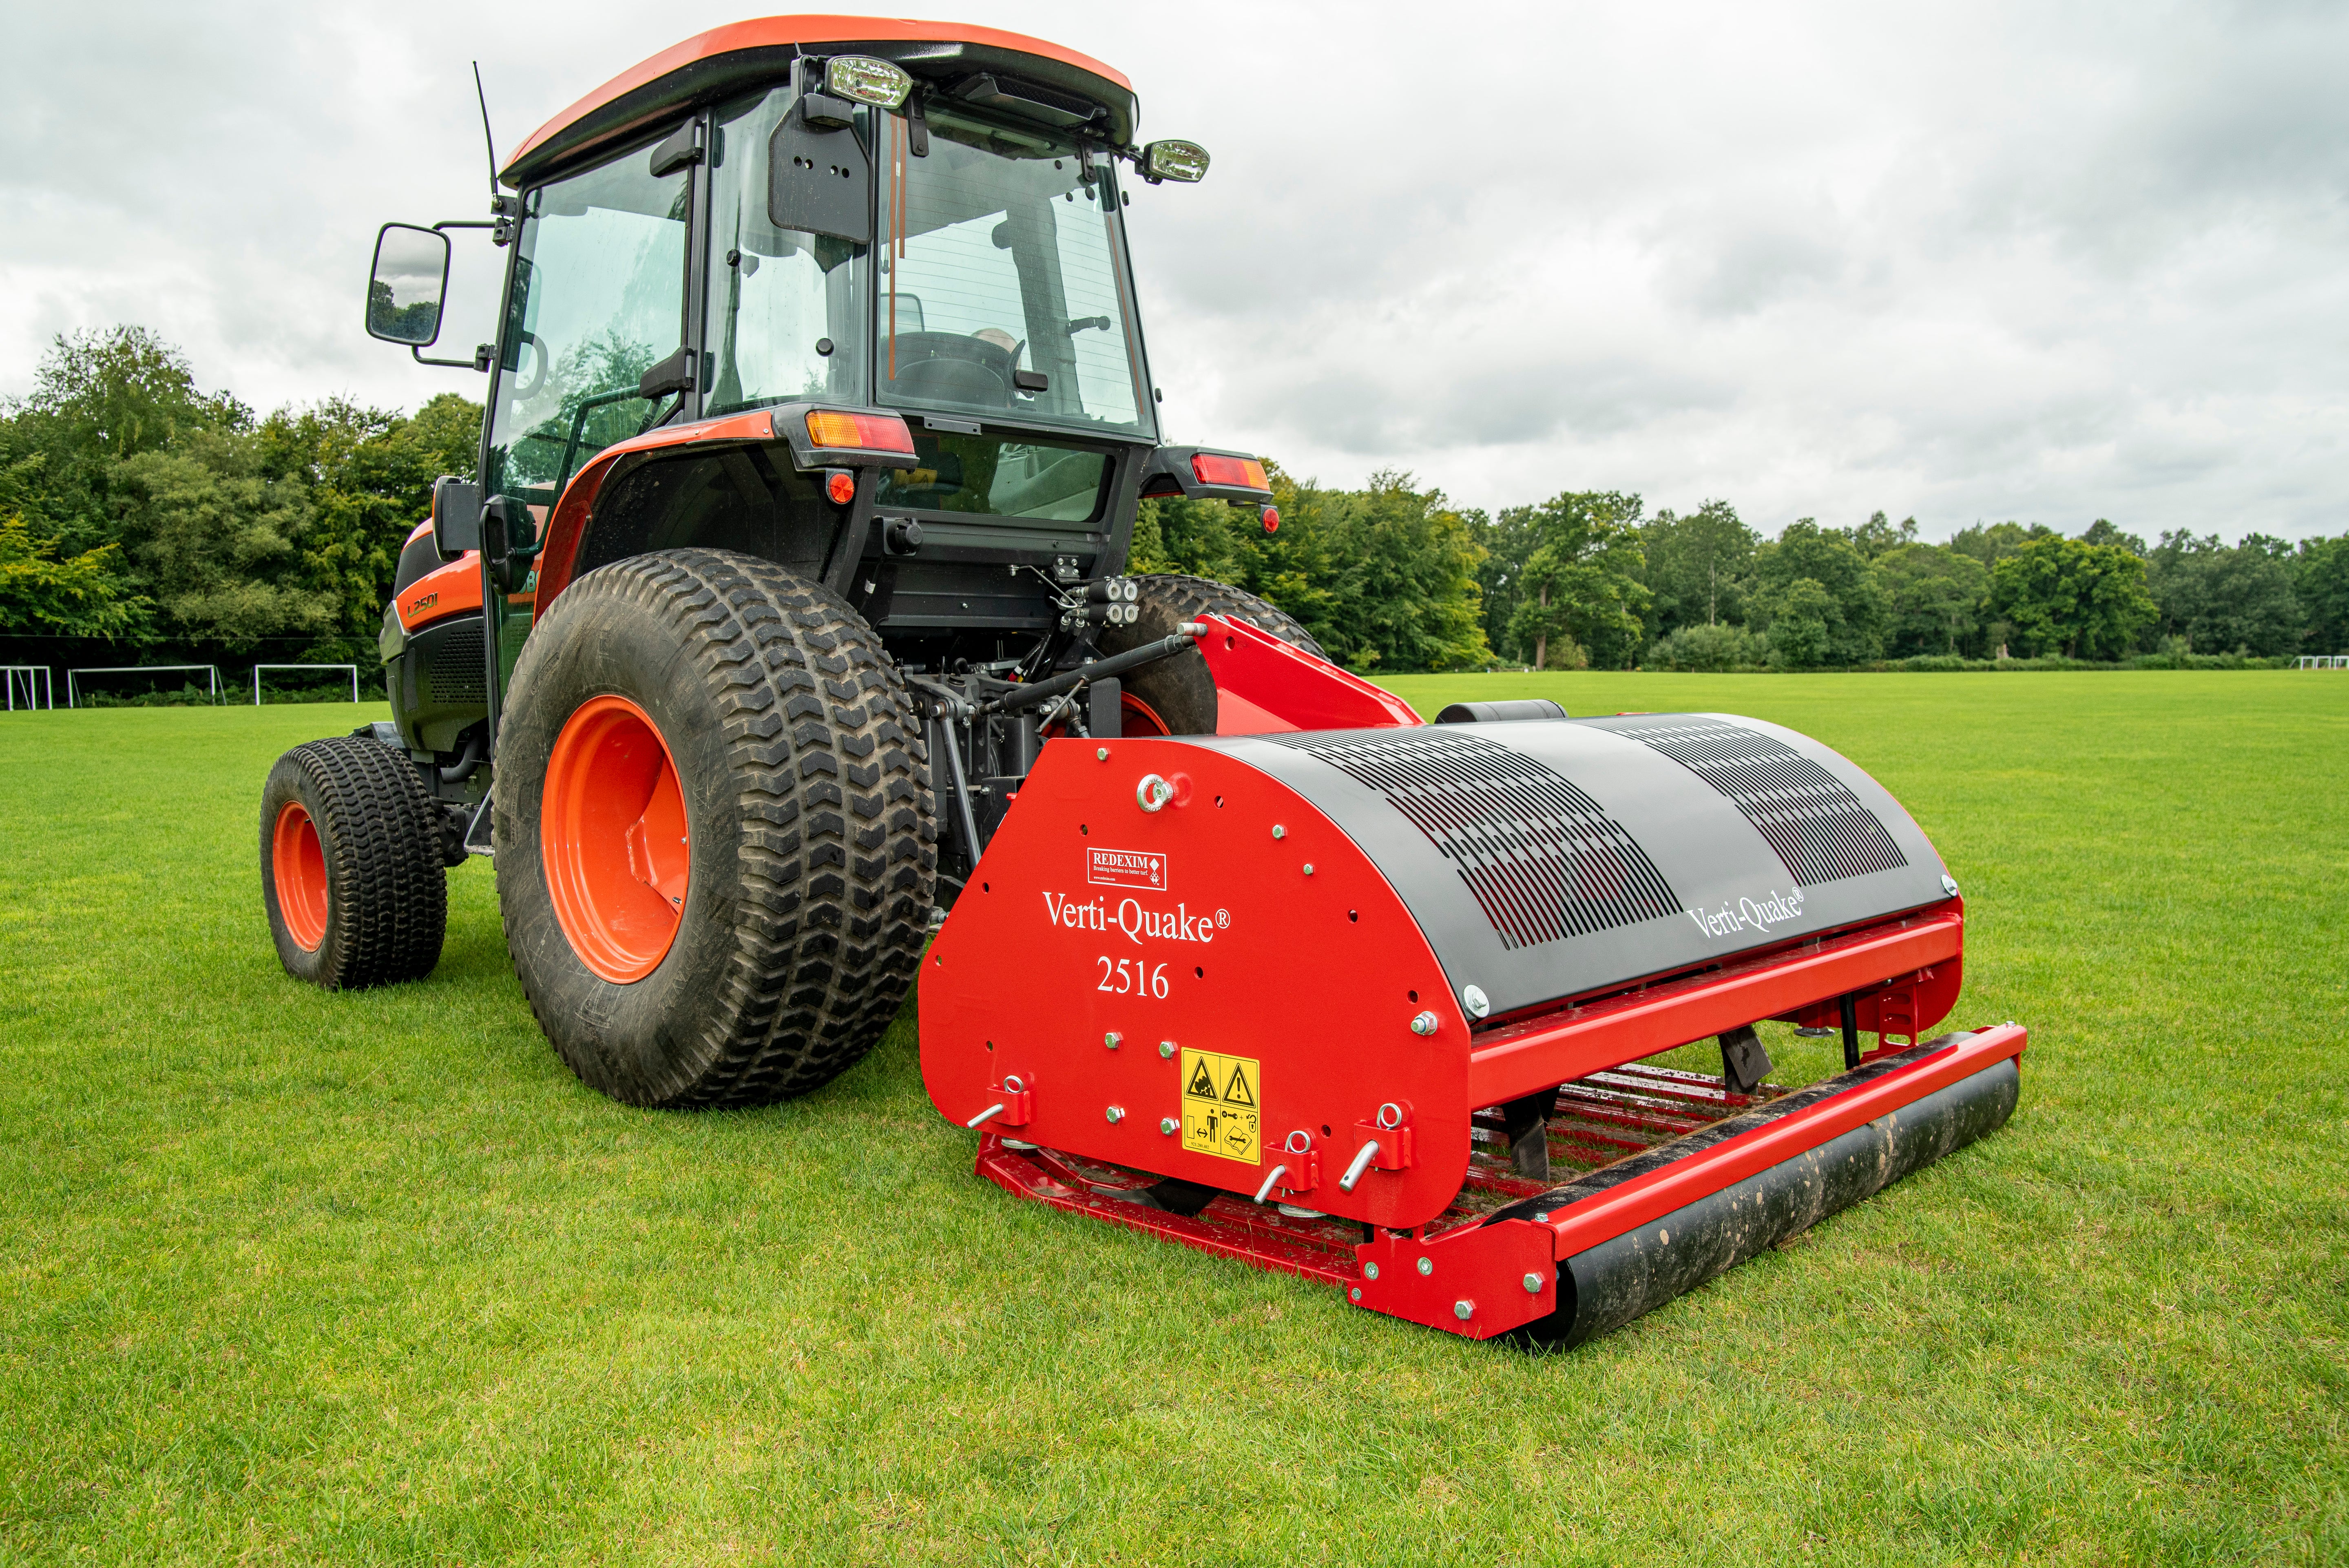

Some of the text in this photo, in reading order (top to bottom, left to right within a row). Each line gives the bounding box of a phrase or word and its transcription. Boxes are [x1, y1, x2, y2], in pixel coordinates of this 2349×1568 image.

[407, 591, 438, 618] L2501
[1093, 852, 1148, 869] REDEXIM
[1097, 956, 1169, 999] 2516
